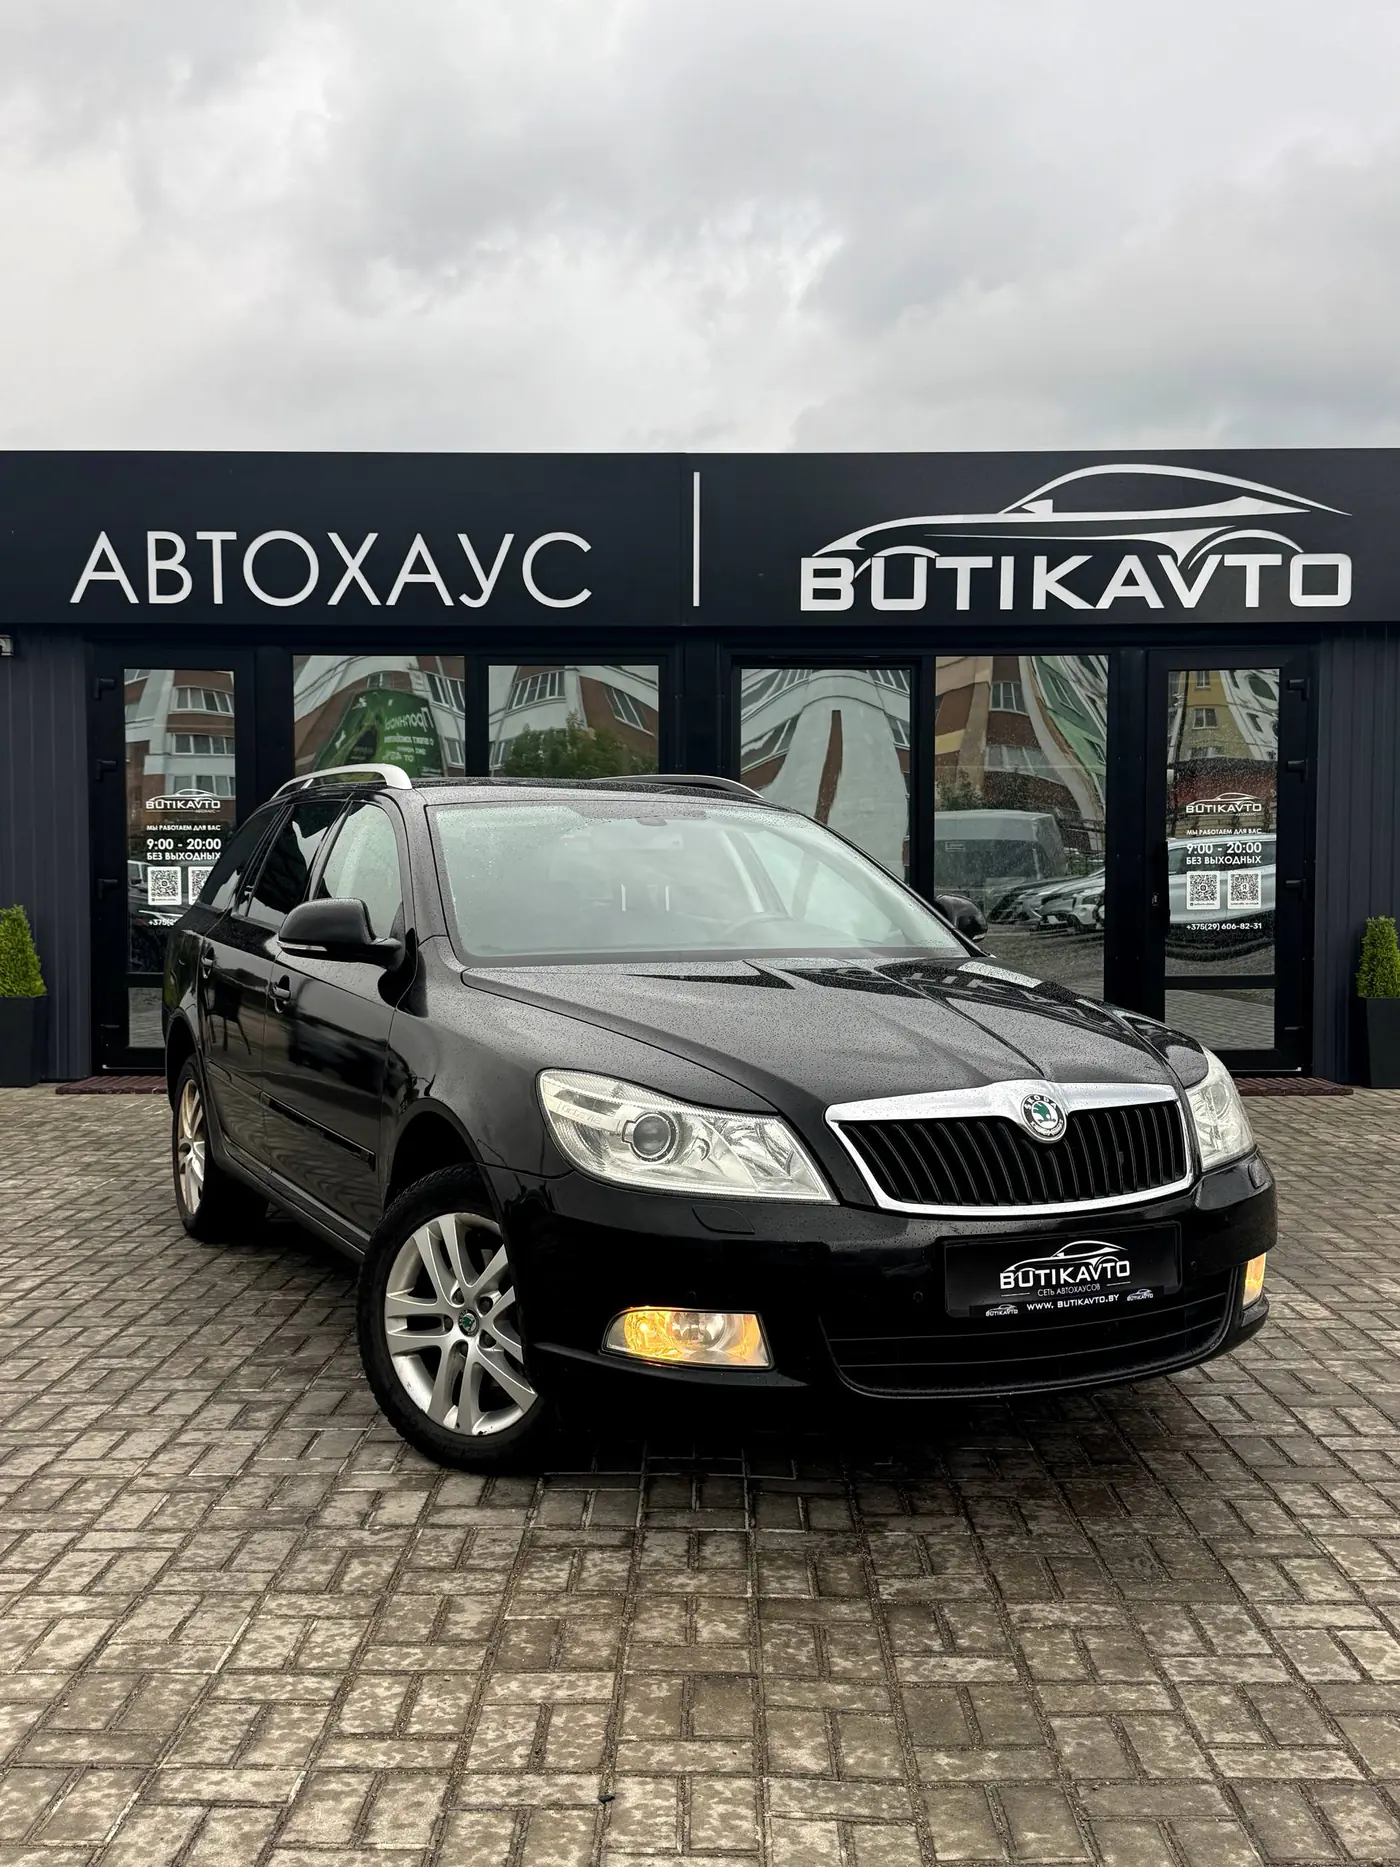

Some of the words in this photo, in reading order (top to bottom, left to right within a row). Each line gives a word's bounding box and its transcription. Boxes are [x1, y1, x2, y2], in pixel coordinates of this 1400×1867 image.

[69, 529, 593, 609] АВТОХАУС
[800, 551, 1353, 613] BUTIKAVTO
[145, 800, 221, 809] BUTIKAVTO
[1185, 804, 1262, 813] BUTIKAVTO
[146, 838, 174, 850] 9:00
[186, 838, 222, 850] 20:00
[1186, 843, 1213, 854] 9:00
[1226, 842, 1262, 853] 20:00
[147, 852, 163, 861] БЕЗ
[165, 852, 221, 861] ВЫХОДНЫХ
[1186, 857, 1202, 865] БЕЗ
[1204, 856, 1262, 865] ВЫХОДНЫХ
[1186, 923, 1220, 931] +375(29)
[1000, 1260, 1131, 1290] BUTIKAVTO
[1037, 1287, 1055, 1297] СЕТЬ
[1056, 1283, 1101, 1295] АВТОХАУСОВ
[1026, 1301, 1054, 1311] WWW.
[1057, 1294, 1120, 1308] BUTIKAVTO.BY
